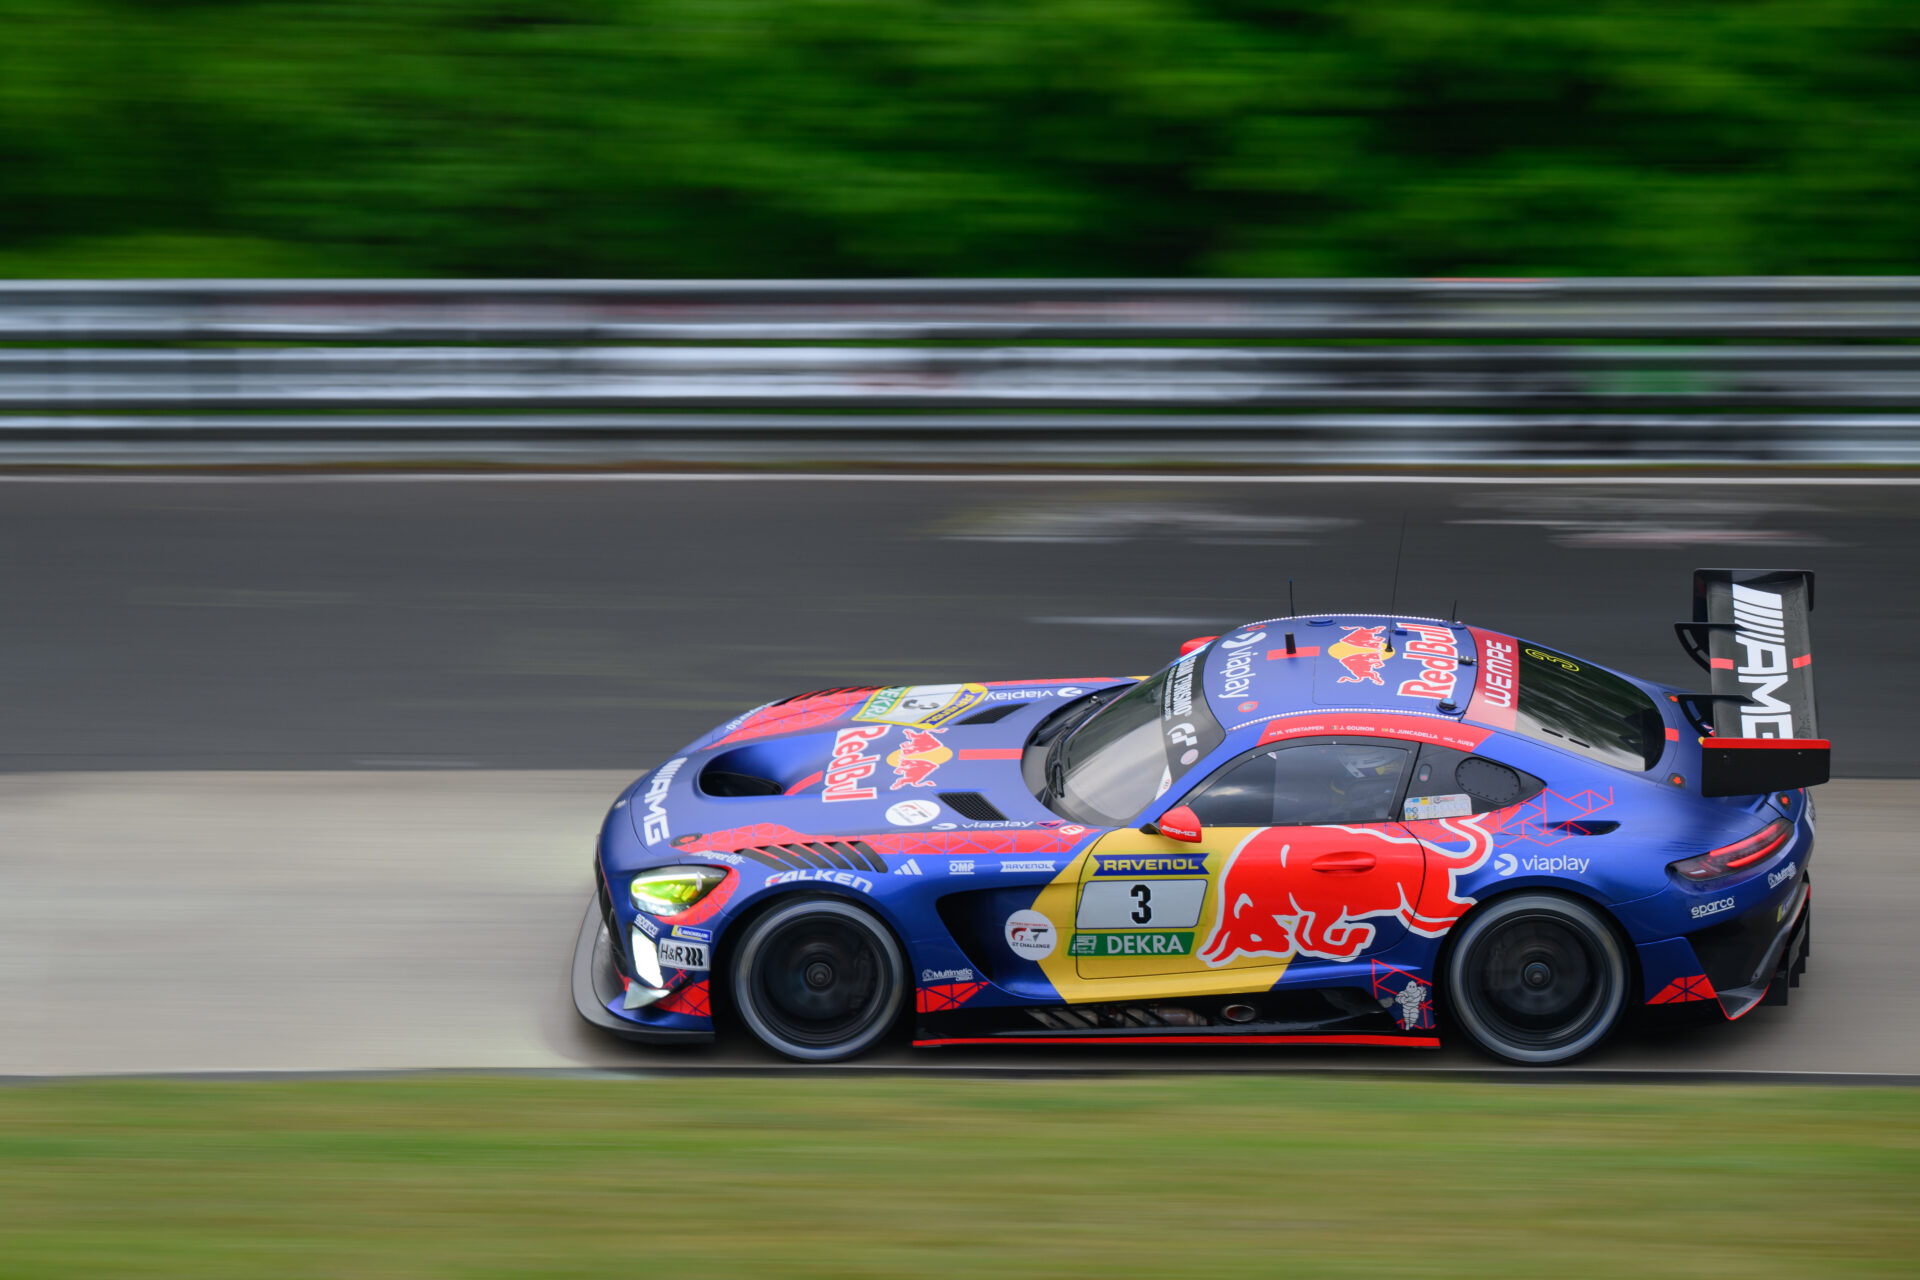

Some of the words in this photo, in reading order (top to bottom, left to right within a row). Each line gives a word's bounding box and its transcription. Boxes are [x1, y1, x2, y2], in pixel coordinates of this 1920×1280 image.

[1396, 622, 1458, 659] Bull
[1218, 646, 1259, 699] viaplay
[1396, 652, 1458, 700] Red
[1484, 640, 1513, 708] WEMPE
[984, 690, 1054, 701] viaplay
[1173, 673, 1192, 716] TURISMO
[902, 699, 940, 710] 3
[1285, 725, 1325, 734] VERSTAPPEN
[1397, 729, 1438, 740] JUNCADELLA
[828, 725, 891, 773] Red
[1457, 739, 1475, 748] AUER
[821, 762, 878, 803] Bull
[962, 820, 1034, 829] viaplay
[949, 861, 975, 873] OMP
[1005, 862, 1052, 870] RAVENOL
[1103, 858, 1199, 871] RAVENOL
[1522, 855, 1590, 874] viaplay
[764, 869, 874, 894] FALKEN
[1130, 884, 1152, 924] 3
[1691, 897, 1734, 918] sparco
[660, 944, 683, 962] H&R
[1107, 934, 1184, 954] DEKRA
[932, 967, 973, 979] Multimatic
